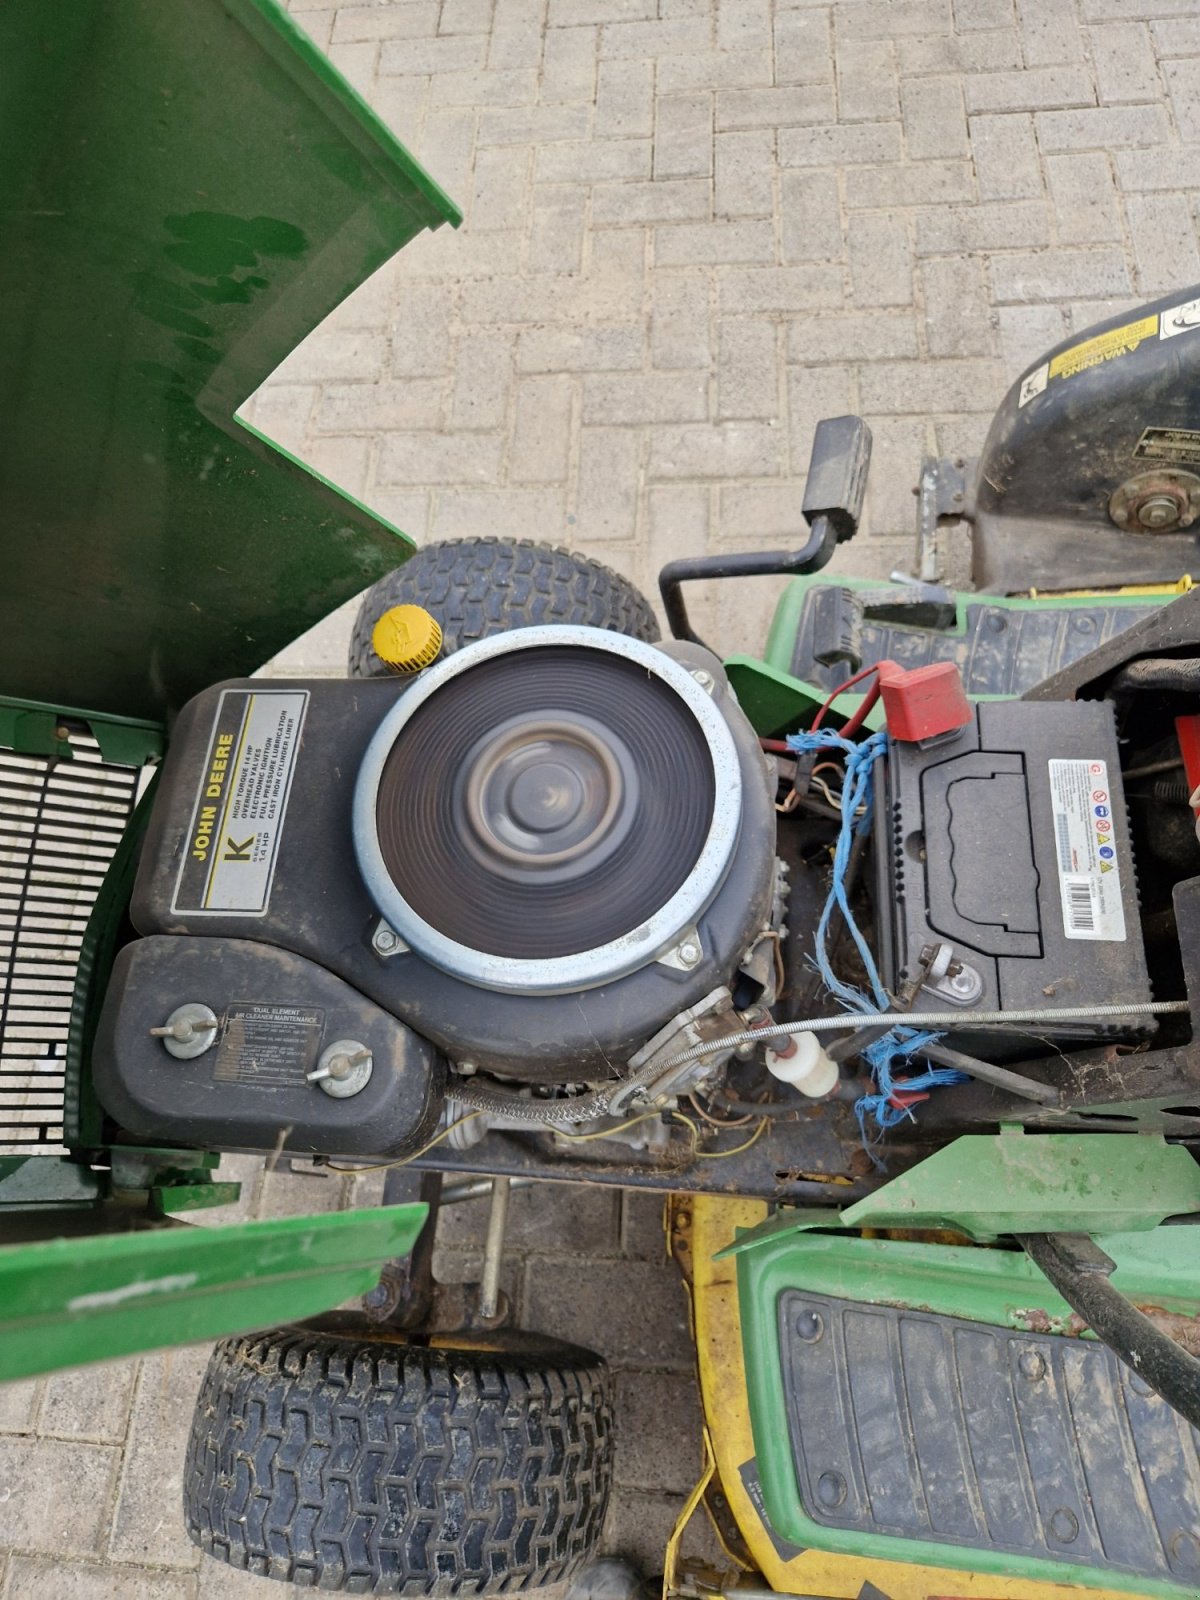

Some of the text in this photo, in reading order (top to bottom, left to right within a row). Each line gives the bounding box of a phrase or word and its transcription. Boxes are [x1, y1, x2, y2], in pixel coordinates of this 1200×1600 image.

[1061, 347, 1126, 379] WARNING
[193, 734, 233, 861] JOHN DEERE
[232, 745, 253, 819] HIGH TORQUE 14 HP
[241, 748, 261, 819] OVERHEAD VALVES
[251, 737, 272, 819] ELECTRONIC IGNITION
[259, 710, 287, 819] FULL PRESSURE LUBRICATION
[268, 718, 294, 819] CAST IRON CYLINDER LINER
[224, 834, 255, 861] K
[253, 832, 262, 862] SERIES
[262, 832, 270, 846] HP
[274, 1015, 317, 1023] MAINTENANCE
